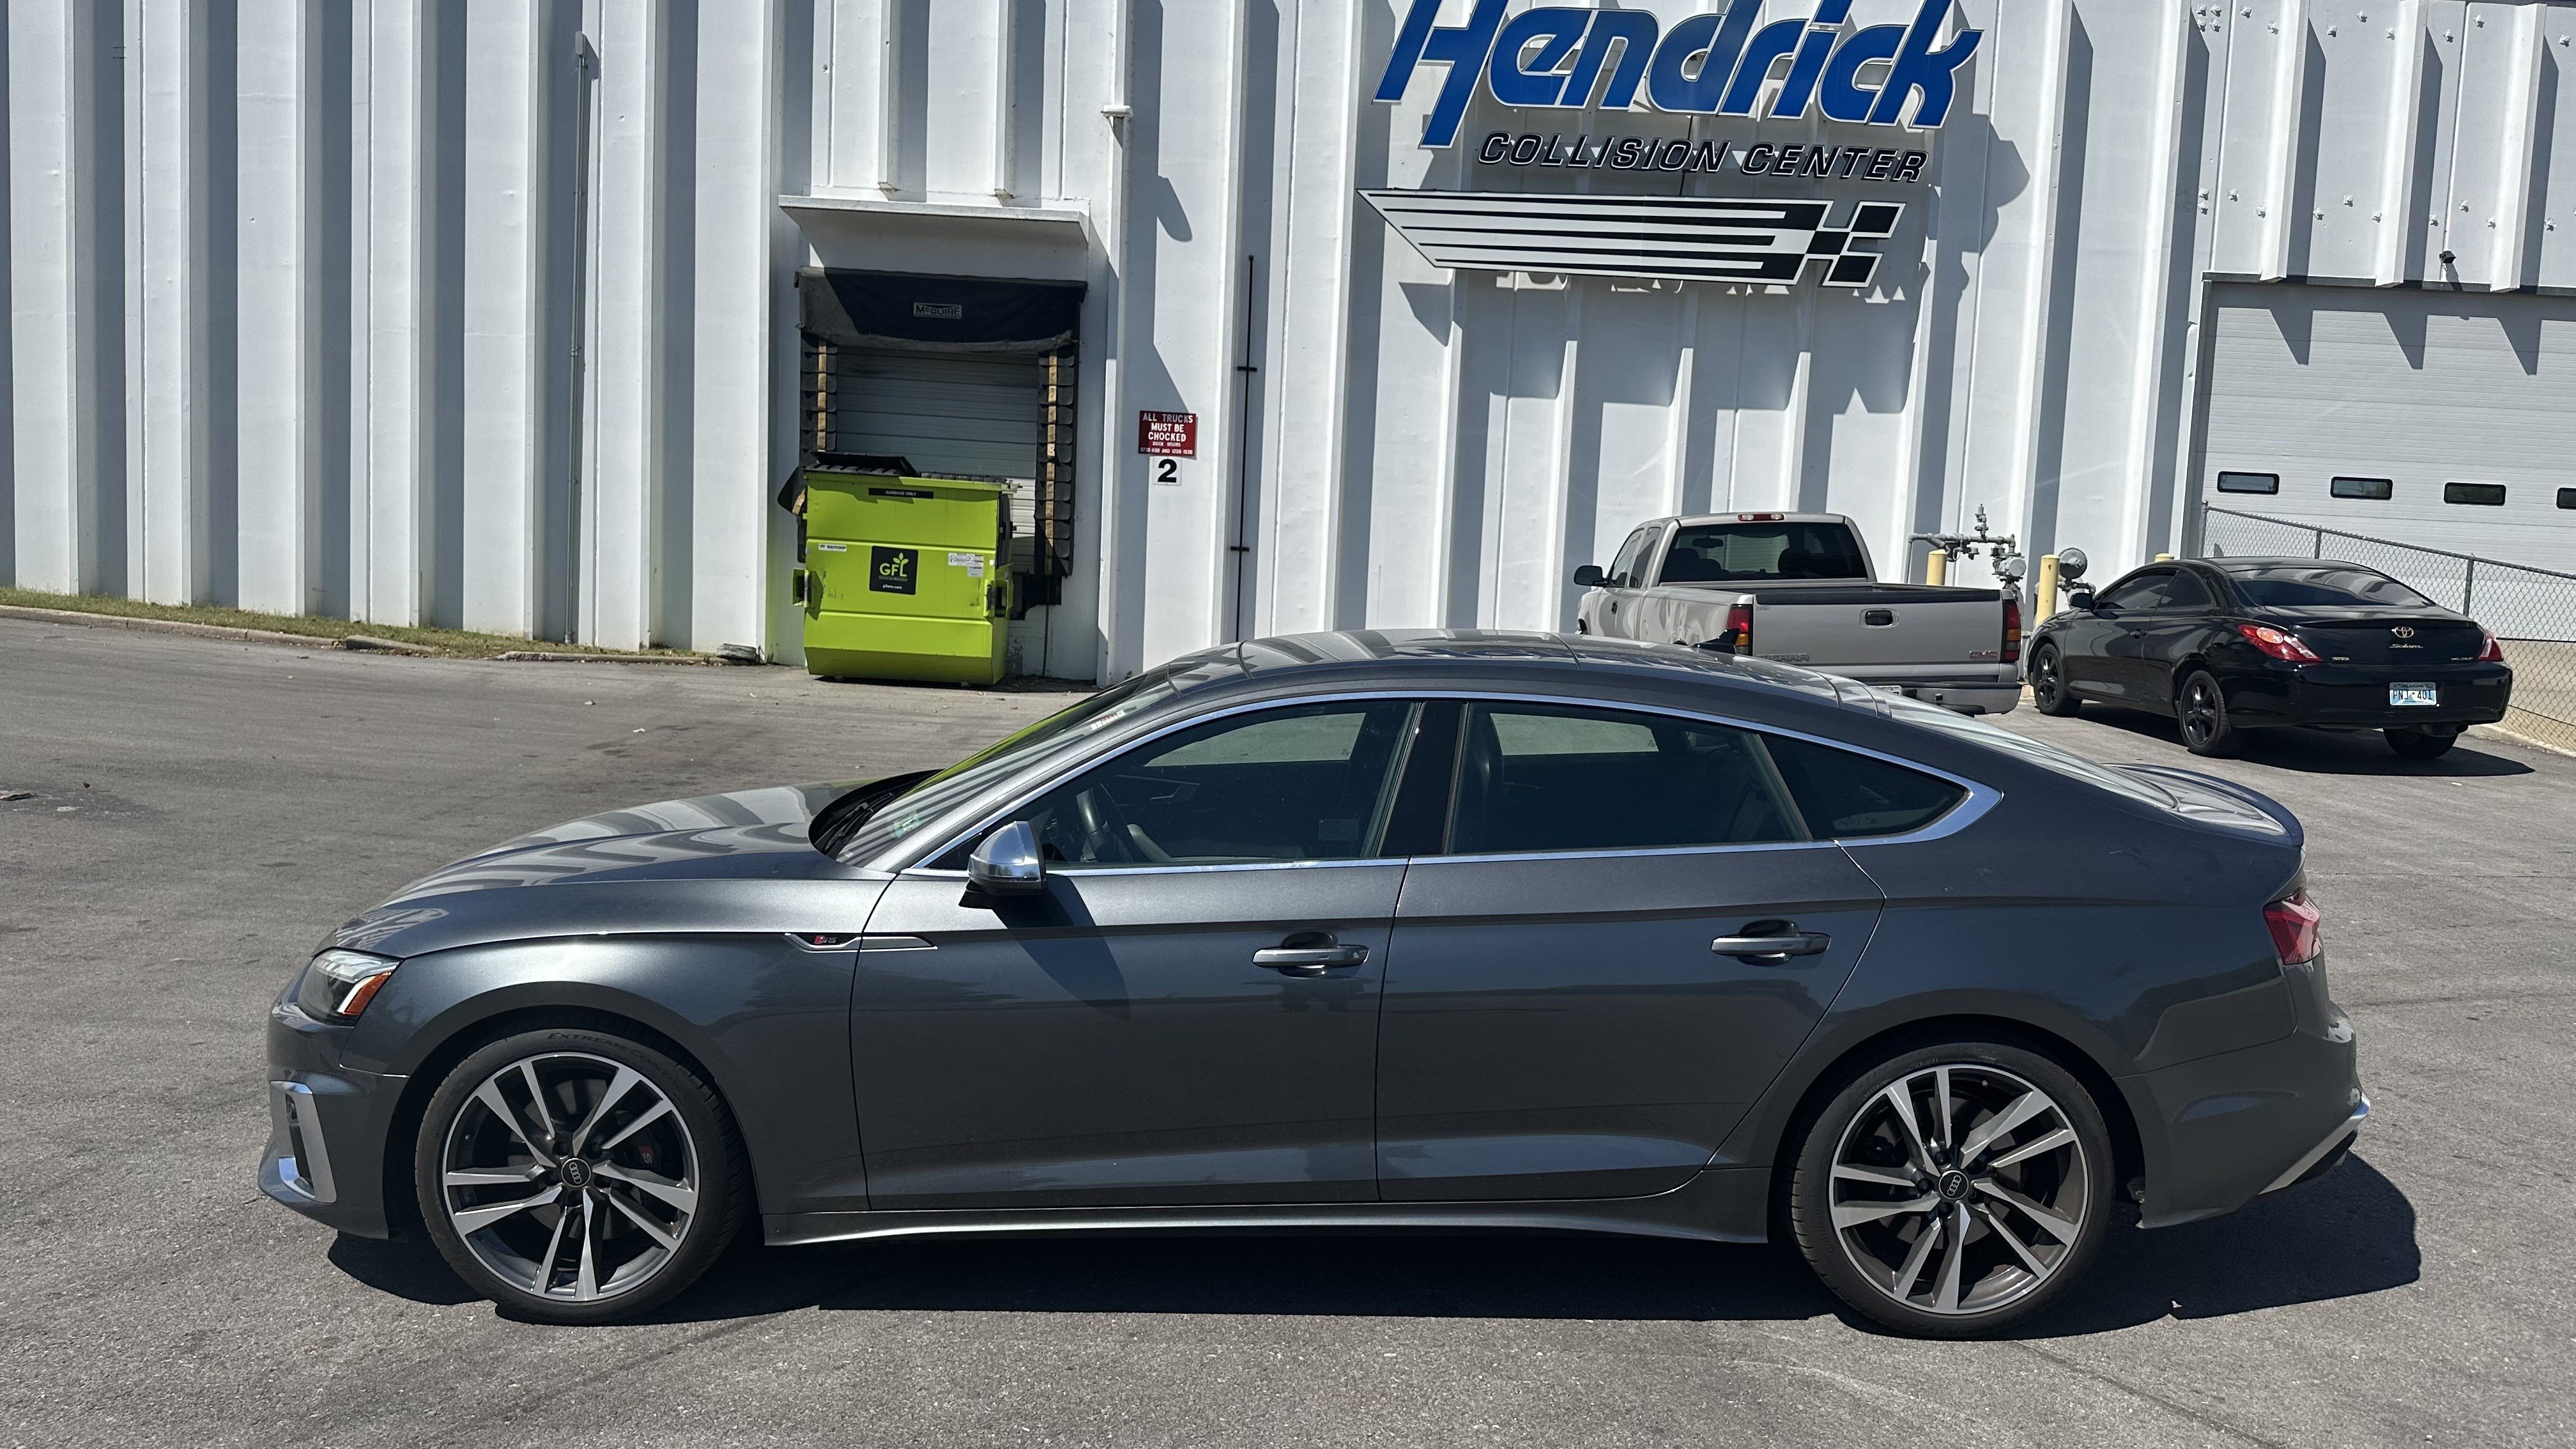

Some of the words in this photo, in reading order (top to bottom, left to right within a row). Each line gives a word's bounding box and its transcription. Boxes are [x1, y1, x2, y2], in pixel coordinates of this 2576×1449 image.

[1372, 0, 1985, 149] Hendrick
[1478, 131, 1731, 173] COLLISION
[1740, 141, 1929, 182] CENTER
[1142, 412, 1158, 422] ALL
[1162, 413, 1193, 424] TRUCKS
[1151, 422, 1172, 432] MUST
[1174, 424, 1184, 433] BE
[1147, 431, 1186, 442] CHOCKED
[1157, 459, 1177, 483] 2
[879, 558, 908, 577] GFL
[1969, 650, 1998, 659] GMC
